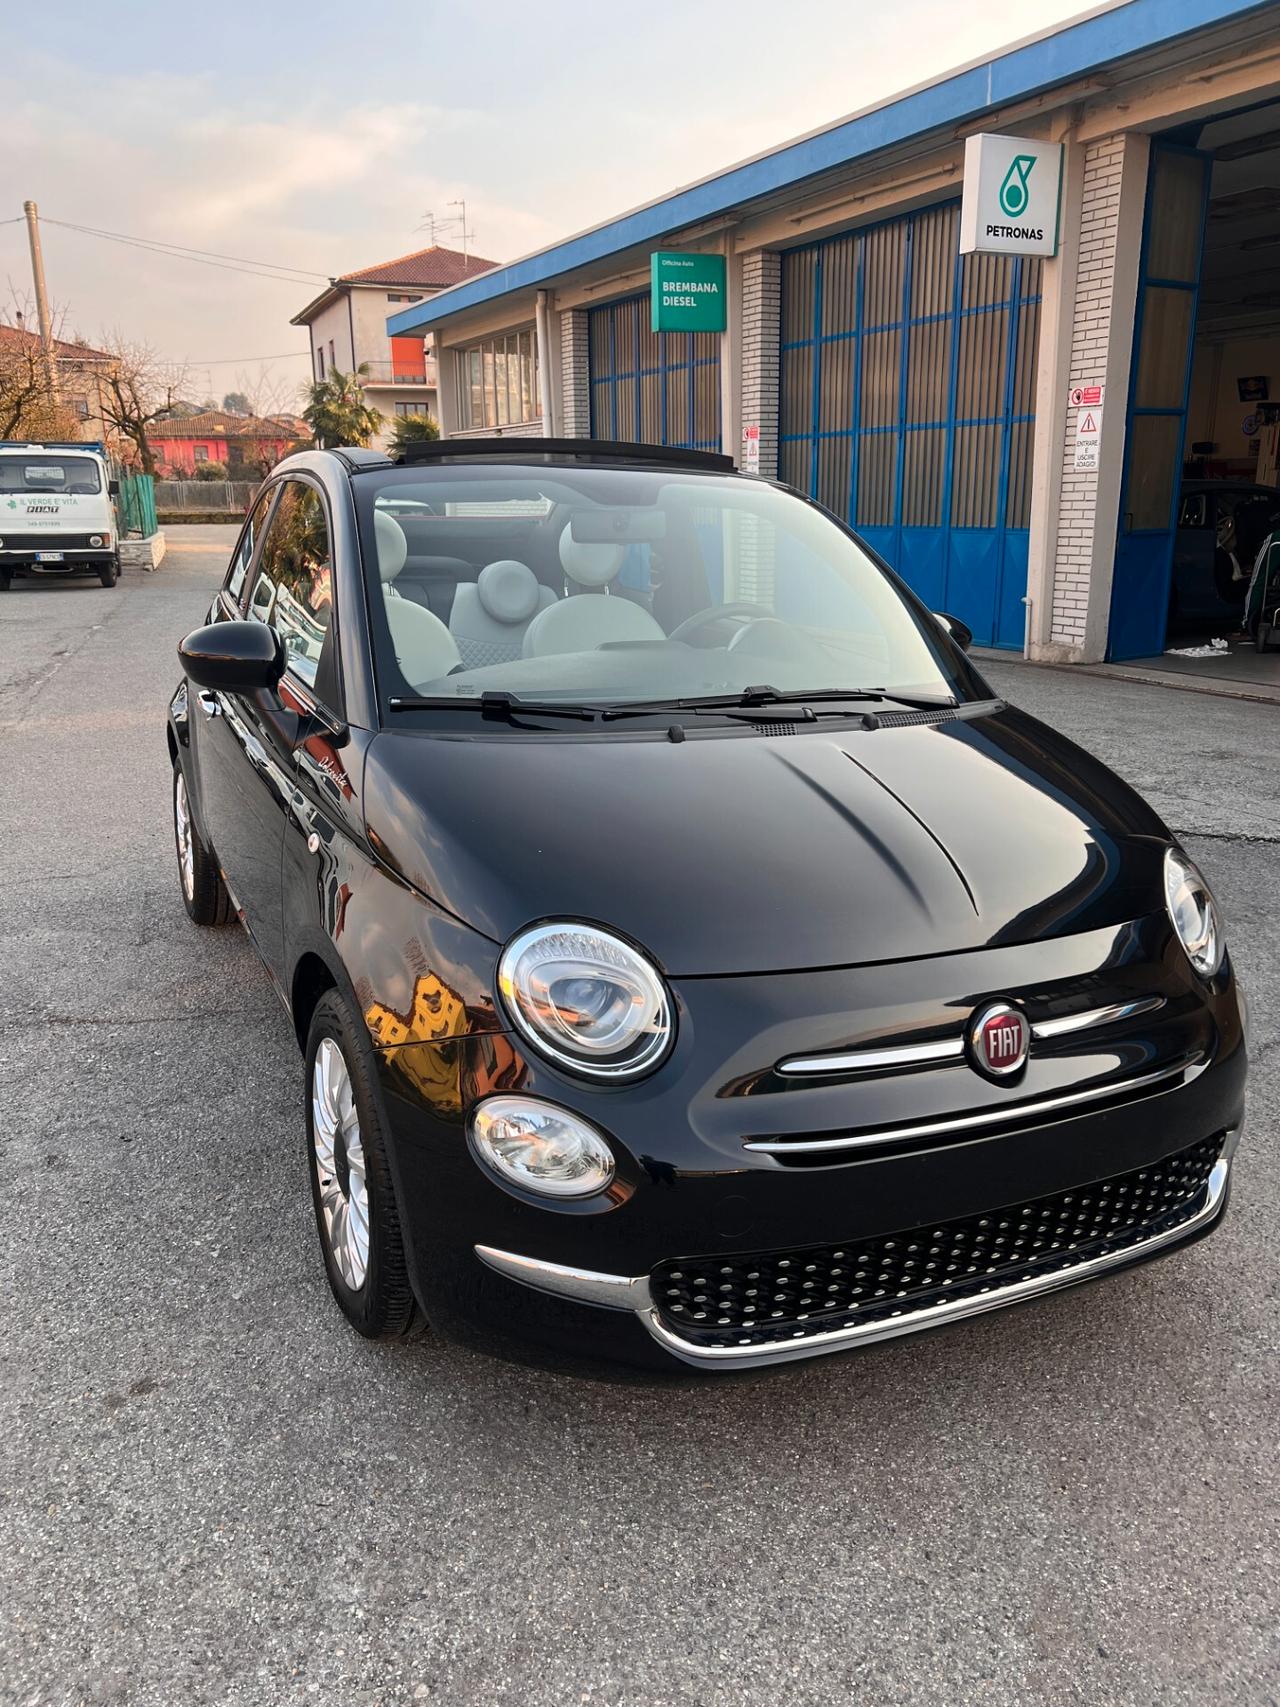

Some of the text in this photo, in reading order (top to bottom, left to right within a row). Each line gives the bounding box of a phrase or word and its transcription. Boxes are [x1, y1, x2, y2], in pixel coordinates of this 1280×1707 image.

[986, 224, 1044, 240] PETRONAS
[662, 281, 718, 293] BREMBANA
[662, 296, 697, 307] DIESEL
[1076, 439, 1098, 447] ENTRARE
[1077, 453, 1095, 461] USCIRE
[20, 498, 26, 506] IL
[989, 1025, 1020, 1059] FIAT
